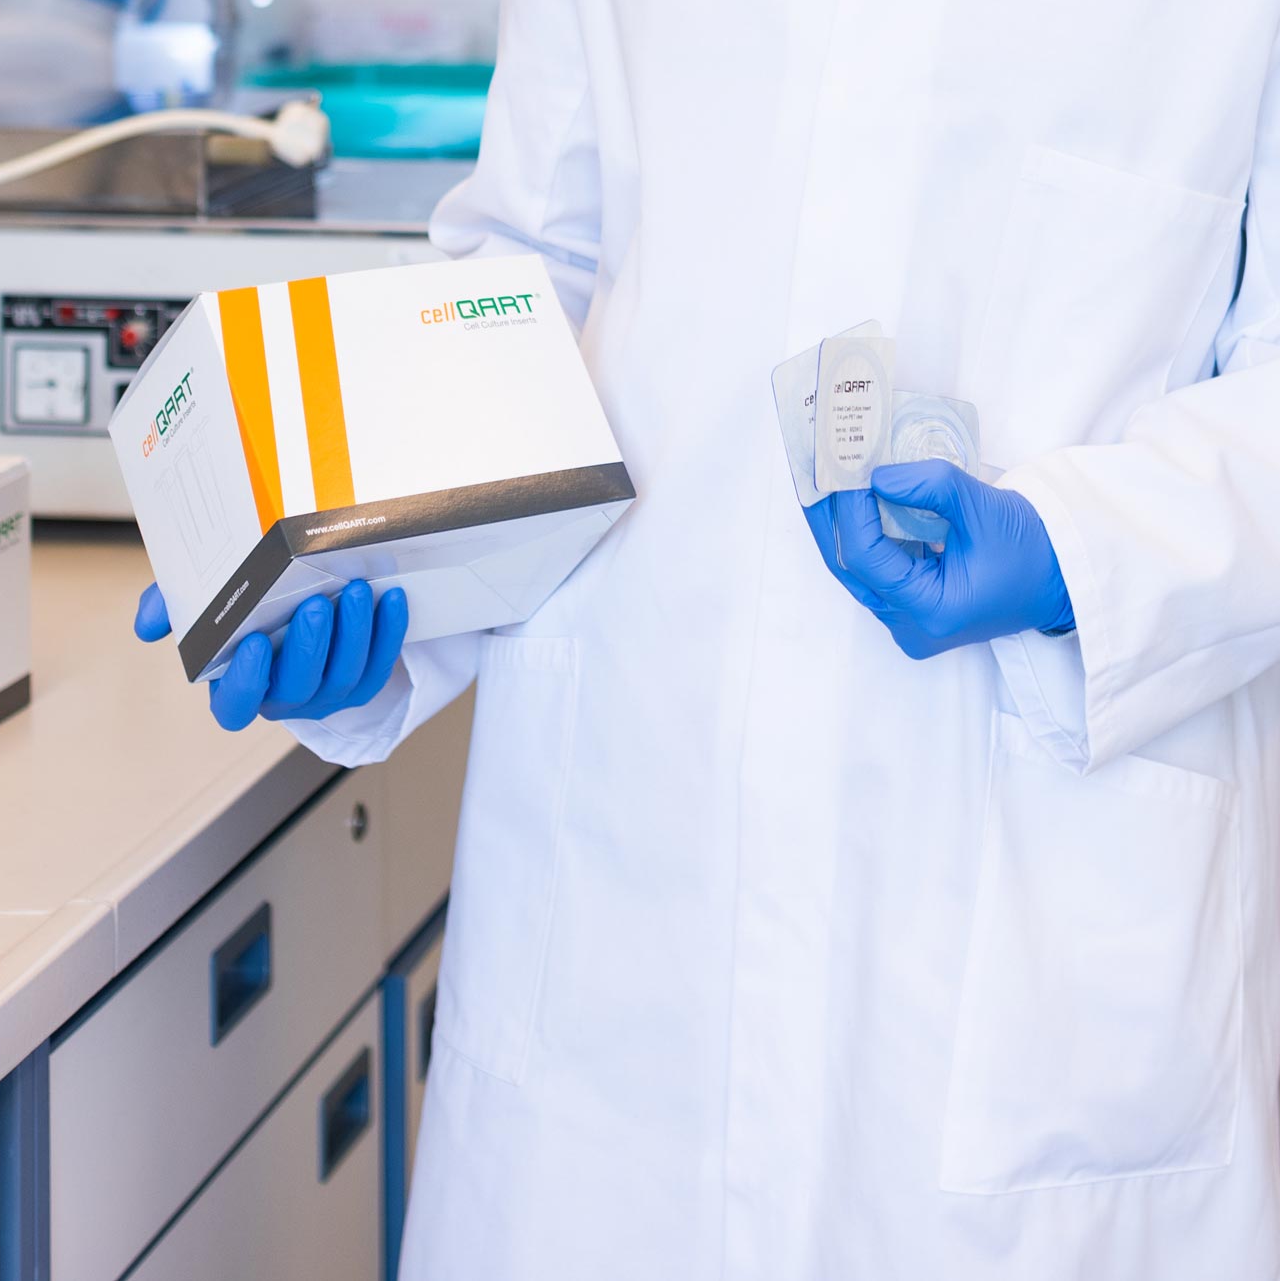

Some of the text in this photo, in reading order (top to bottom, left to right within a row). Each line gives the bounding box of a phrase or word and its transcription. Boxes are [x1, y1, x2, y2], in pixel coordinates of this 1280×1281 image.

[420, 293, 534, 324] cellQART
[463, 316, 537, 331] Cell Culture Inserts
[834, 380, 871, 394] cellQART
[142, 372, 193, 458] cellQART
[305, 516, 386, 536] www.cellQART.com
